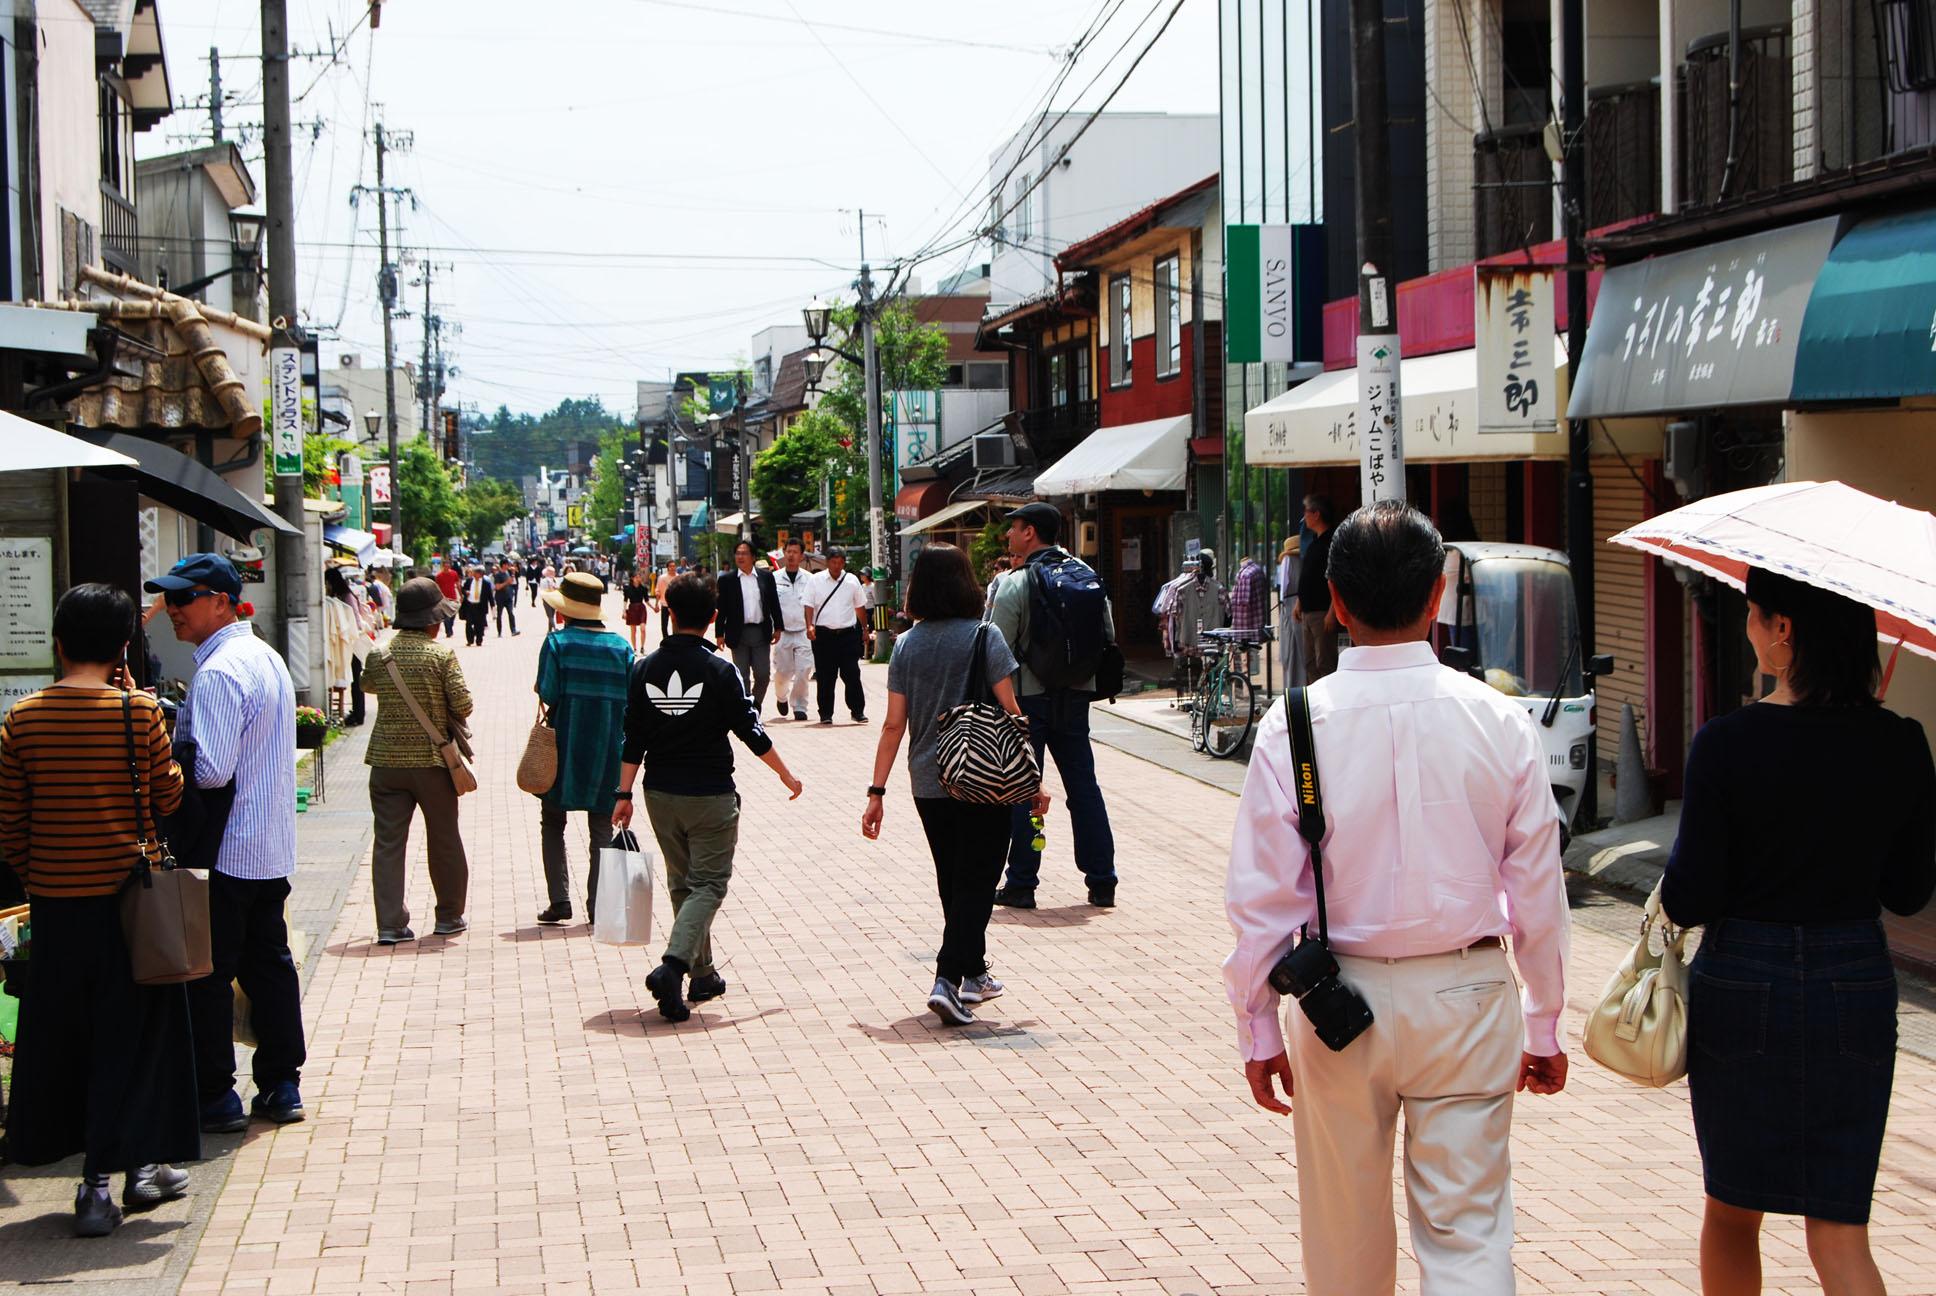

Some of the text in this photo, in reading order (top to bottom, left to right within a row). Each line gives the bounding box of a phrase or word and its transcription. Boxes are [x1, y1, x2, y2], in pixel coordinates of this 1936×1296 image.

[281, 352, 298, 430] ステンドグラス
[1301, 762, 1316, 805] Nikon
